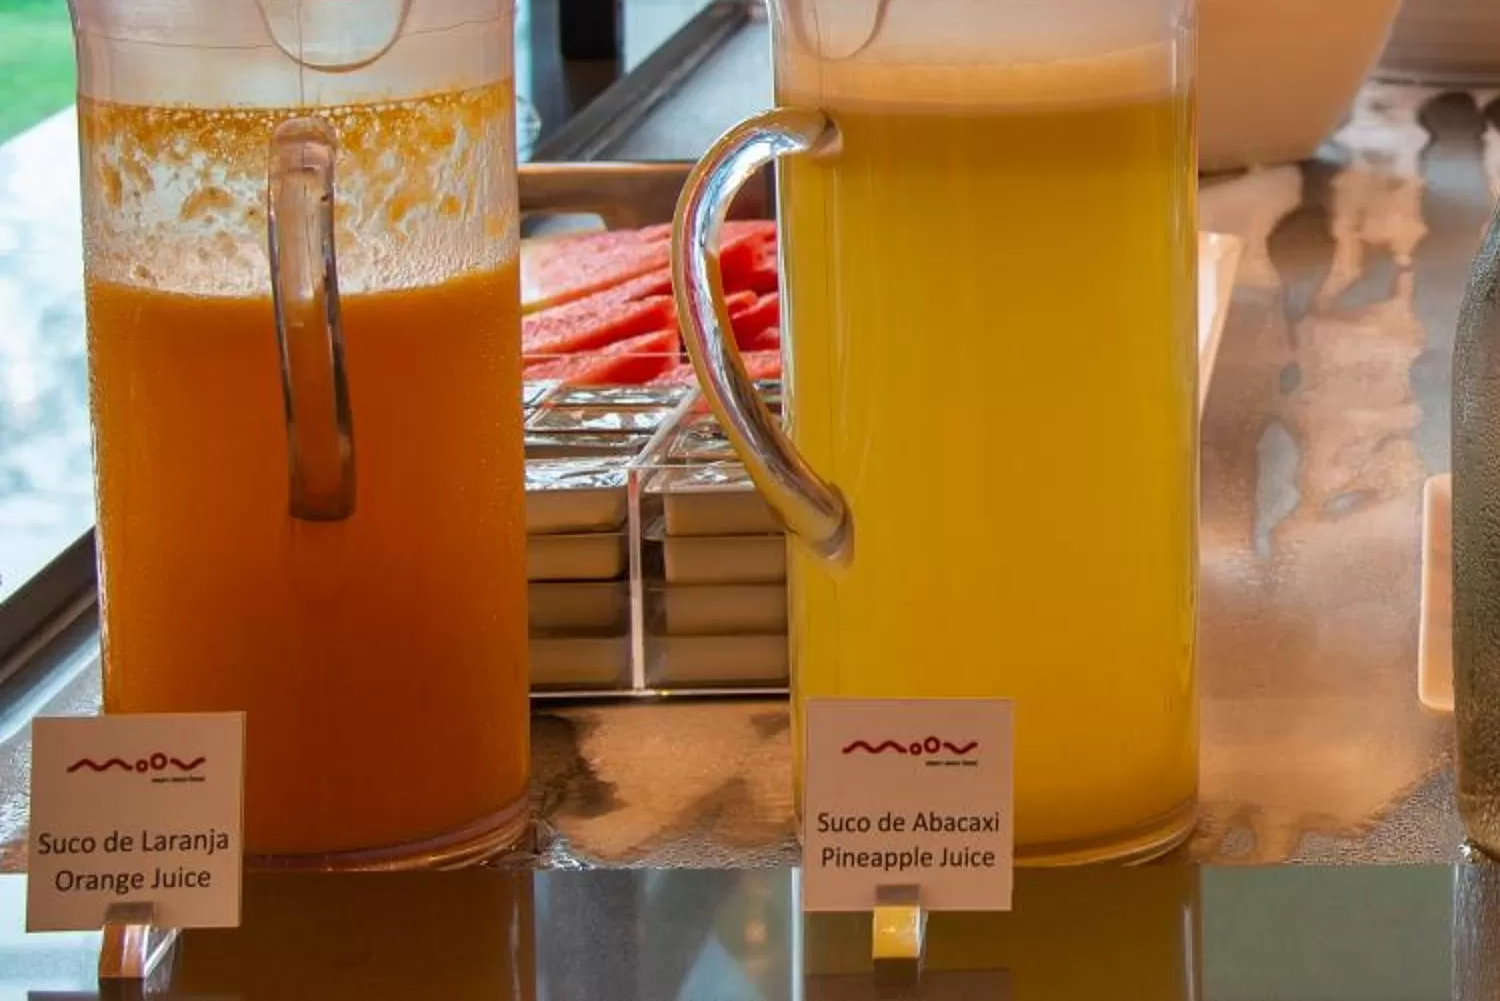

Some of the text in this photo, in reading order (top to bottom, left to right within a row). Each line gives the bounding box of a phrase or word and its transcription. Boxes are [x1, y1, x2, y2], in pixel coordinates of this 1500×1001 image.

[816, 811, 1000, 833] Suco de Abacaxi
[37, 829, 229, 856] Suco de Laranja
[821, 847, 996, 871] Pineapple Juice
[55, 868, 212, 895] Orange Juice
